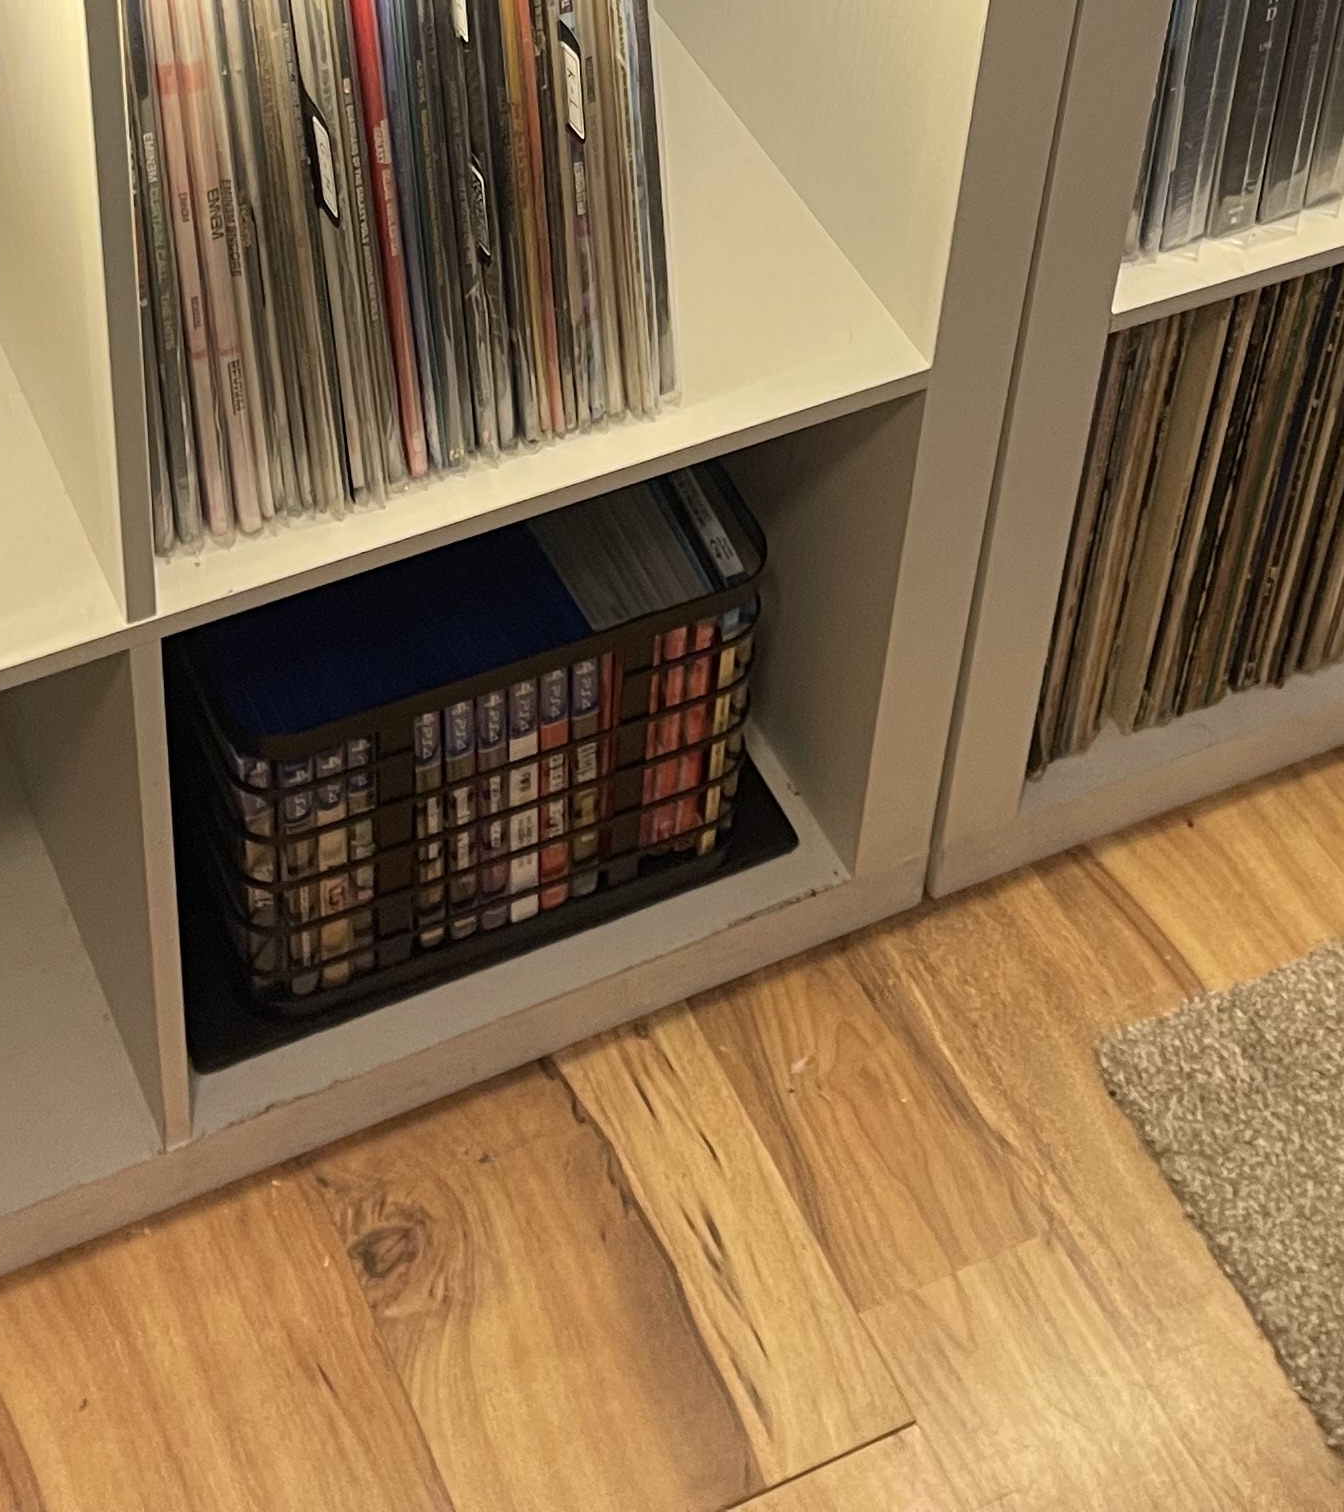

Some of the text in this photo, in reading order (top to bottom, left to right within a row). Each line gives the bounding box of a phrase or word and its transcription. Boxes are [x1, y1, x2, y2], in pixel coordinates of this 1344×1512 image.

[345, 103, 358, 156] GUARDIANS
[352, 156, 360, 168] OF
[353, 168, 362, 186] THE
[148, 185, 164, 247] CURTAIN
[355, 186, 366, 221] GALAXY
[154, 247, 168, 284] CALL
[160, 291, 171, 318] THE
[162, 318, 175, 351] HITS
